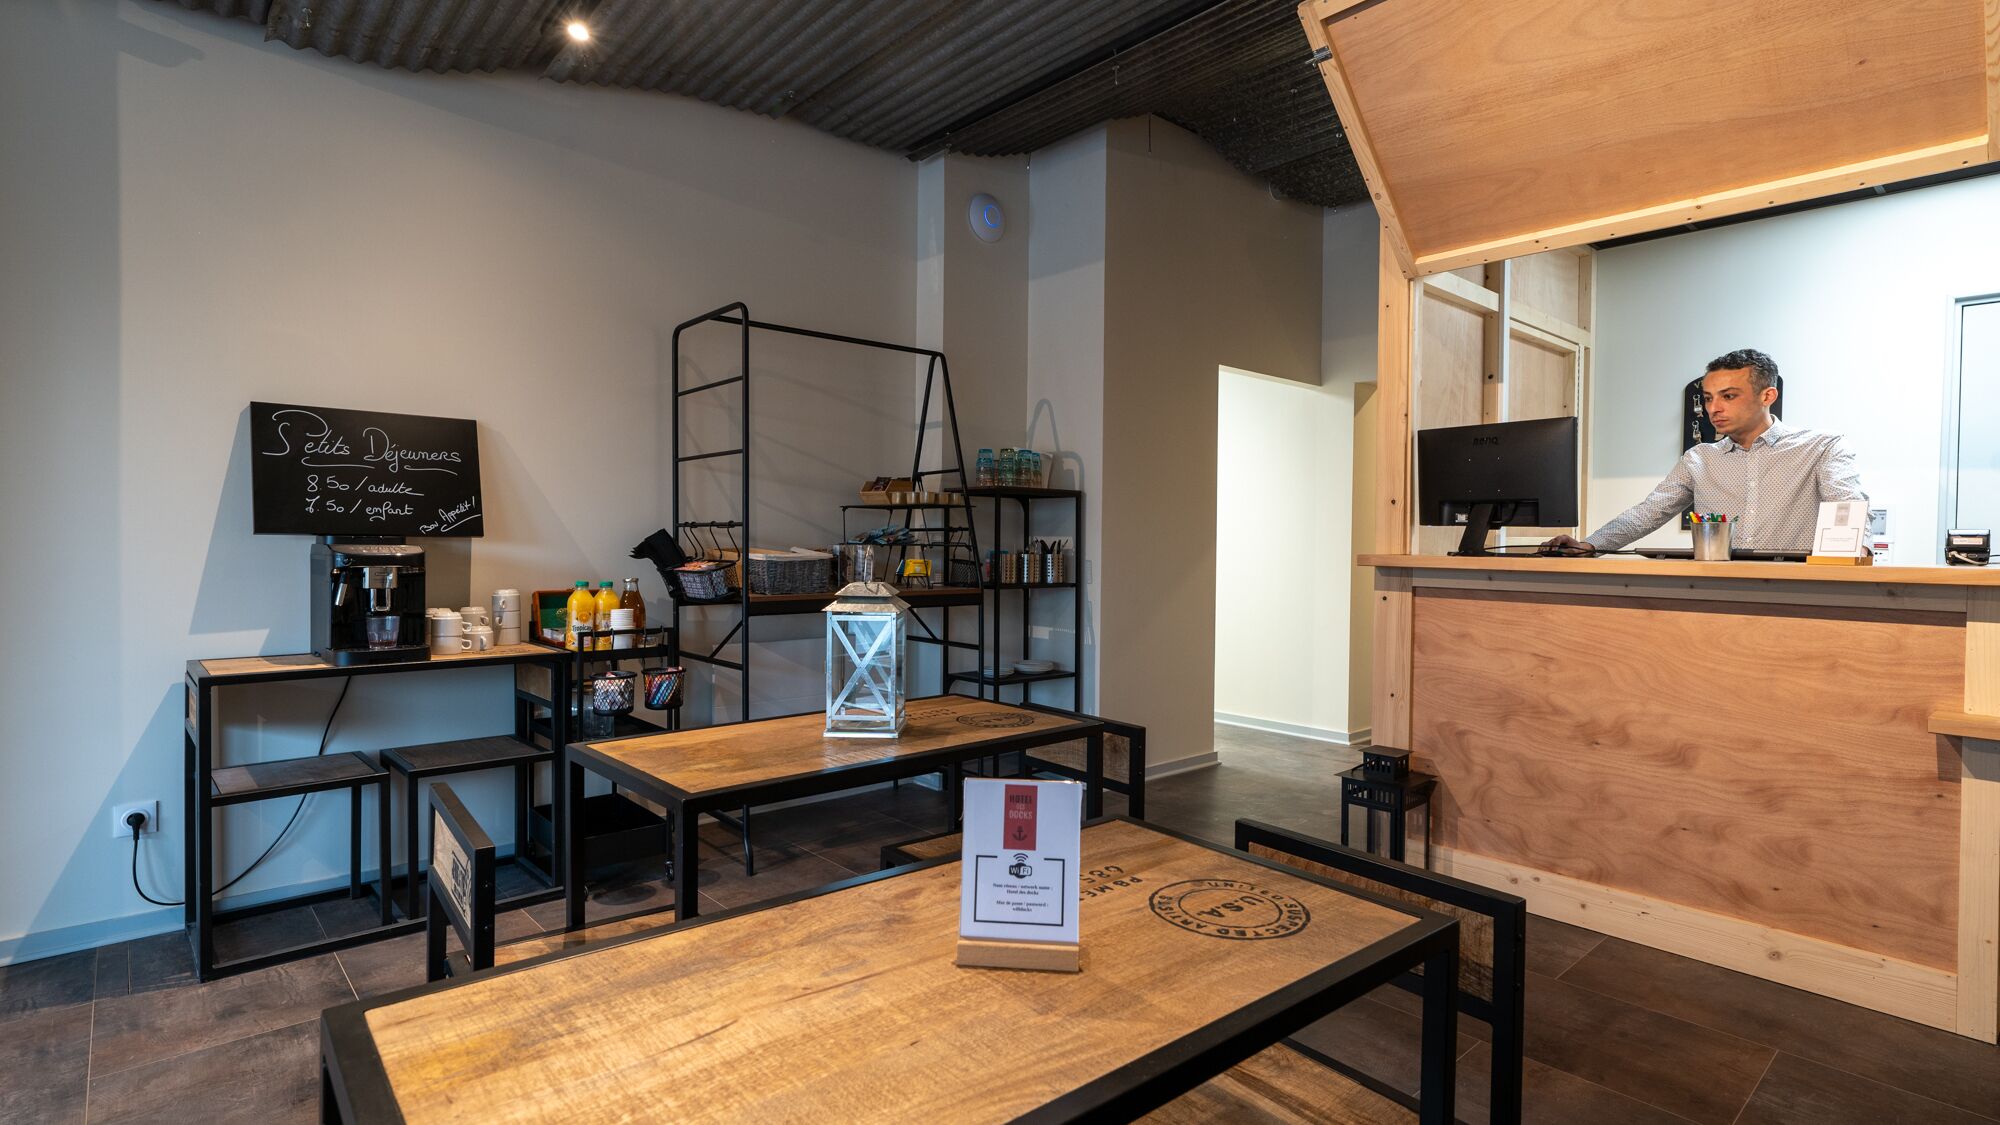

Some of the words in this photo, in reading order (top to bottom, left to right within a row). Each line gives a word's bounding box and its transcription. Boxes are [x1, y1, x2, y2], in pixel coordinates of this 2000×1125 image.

[262, 410, 350, 456] Petits
[362, 427, 462, 473] Déjeuners
[368, 482, 424, 497] adulte
[366, 501, 414, 522] enfant
